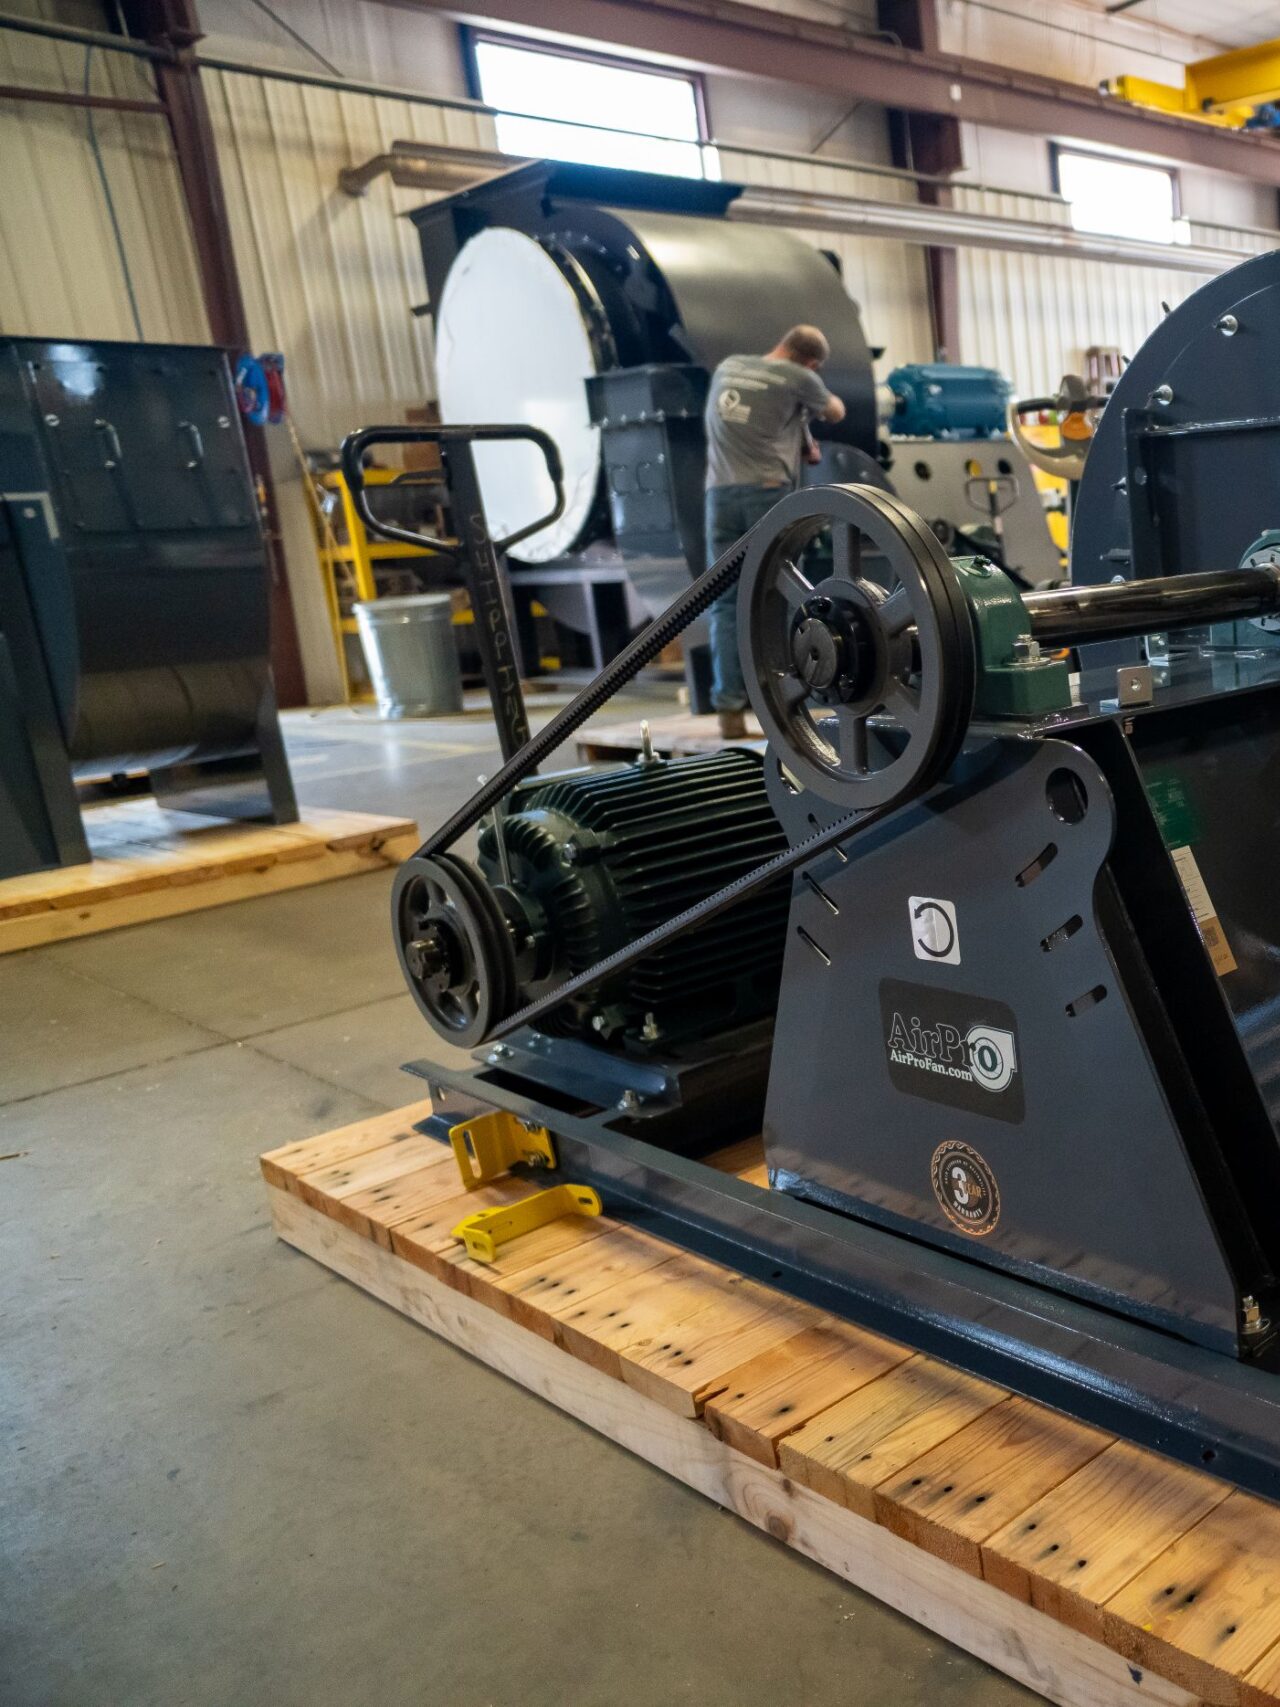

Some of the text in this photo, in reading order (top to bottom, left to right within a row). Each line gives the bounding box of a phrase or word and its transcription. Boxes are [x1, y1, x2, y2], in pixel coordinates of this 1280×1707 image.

[888, 1012, 999, 1073] AirPro
[890, 1048, 974, 1082] AirProFan.com
[952, 1166, 969, 1205] 3
[953, 1201, 983, 1218] WARRANTY
